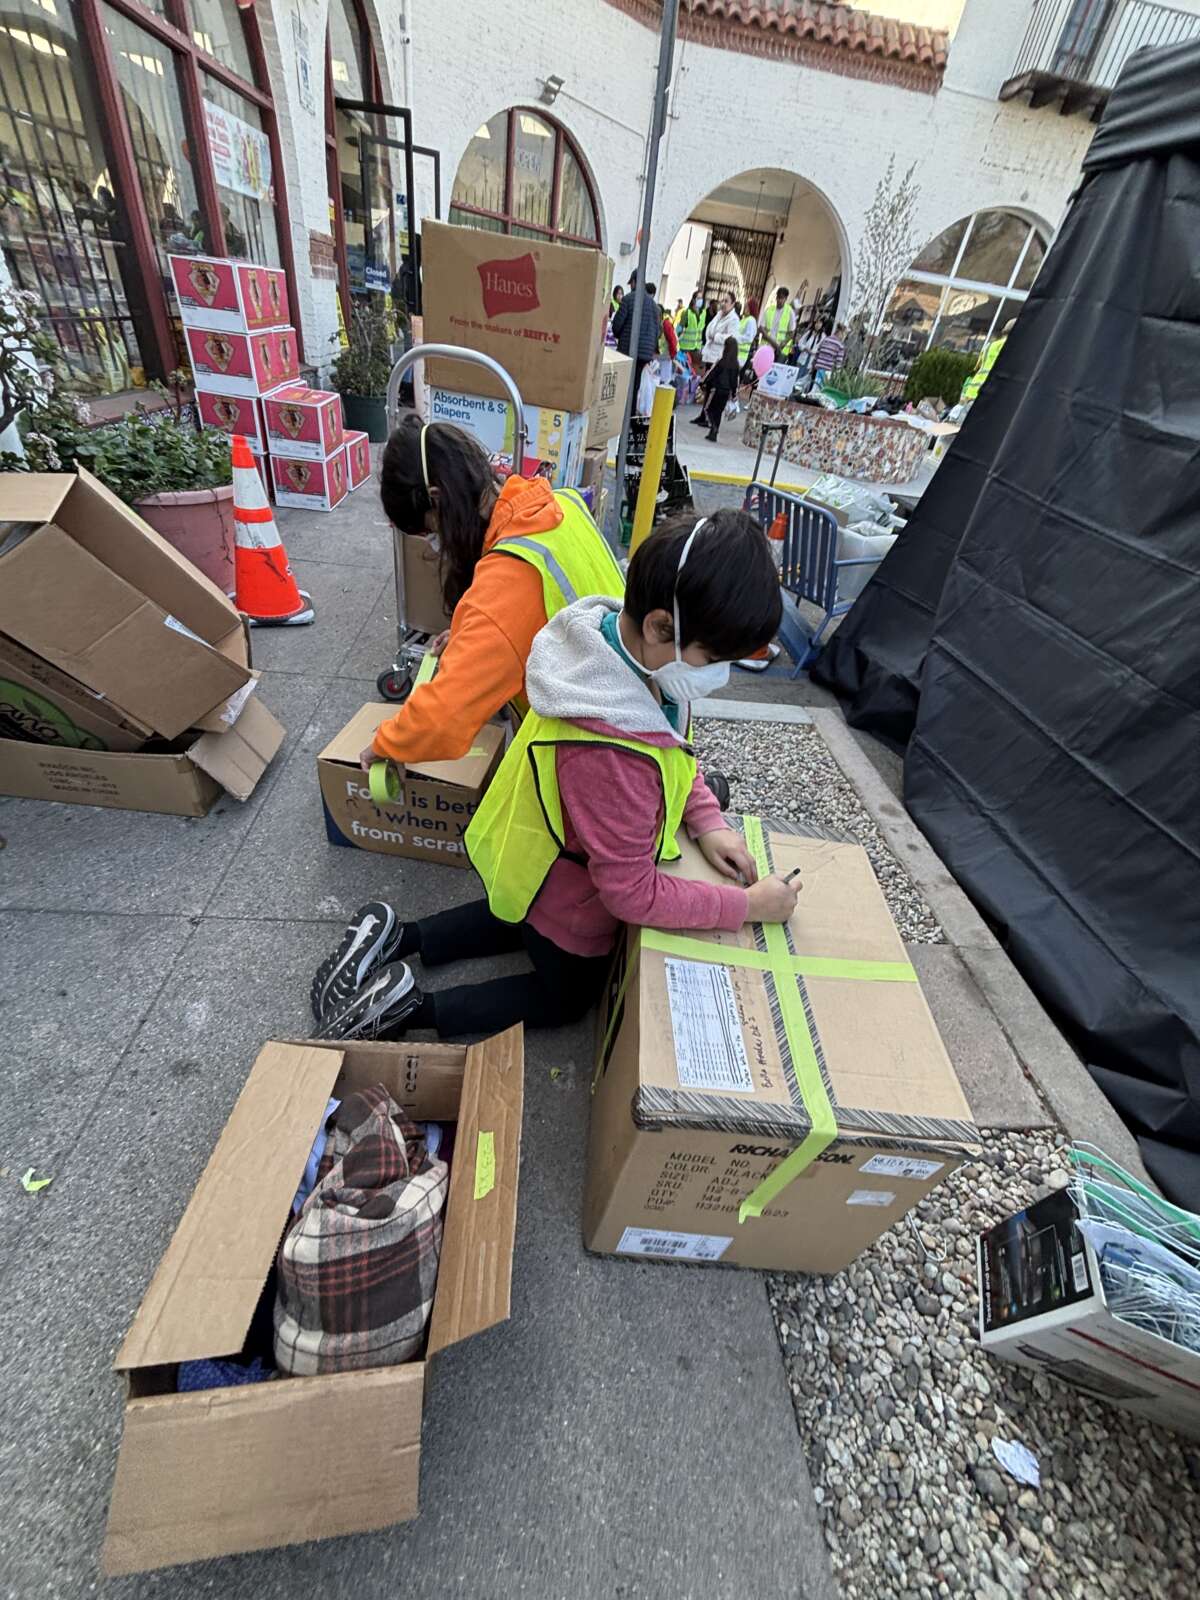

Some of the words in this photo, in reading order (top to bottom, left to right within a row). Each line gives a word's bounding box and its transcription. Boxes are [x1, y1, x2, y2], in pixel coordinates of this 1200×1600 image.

[486, 271, 533, 297] Hanes
[433, 391, 486, 412] Absorbent
[487, 401, 495, 412] &
[433, 403, 471, 420] Diapers
[553, 414, 561, 428] 5
[411, 790, 429, 809] is
[385, 811, 448, 832] when
[351, 820, 405, 844] from
[670, 1151, 718, 1165] MODEL
[724, 1168, 768, 1181] BLACK
